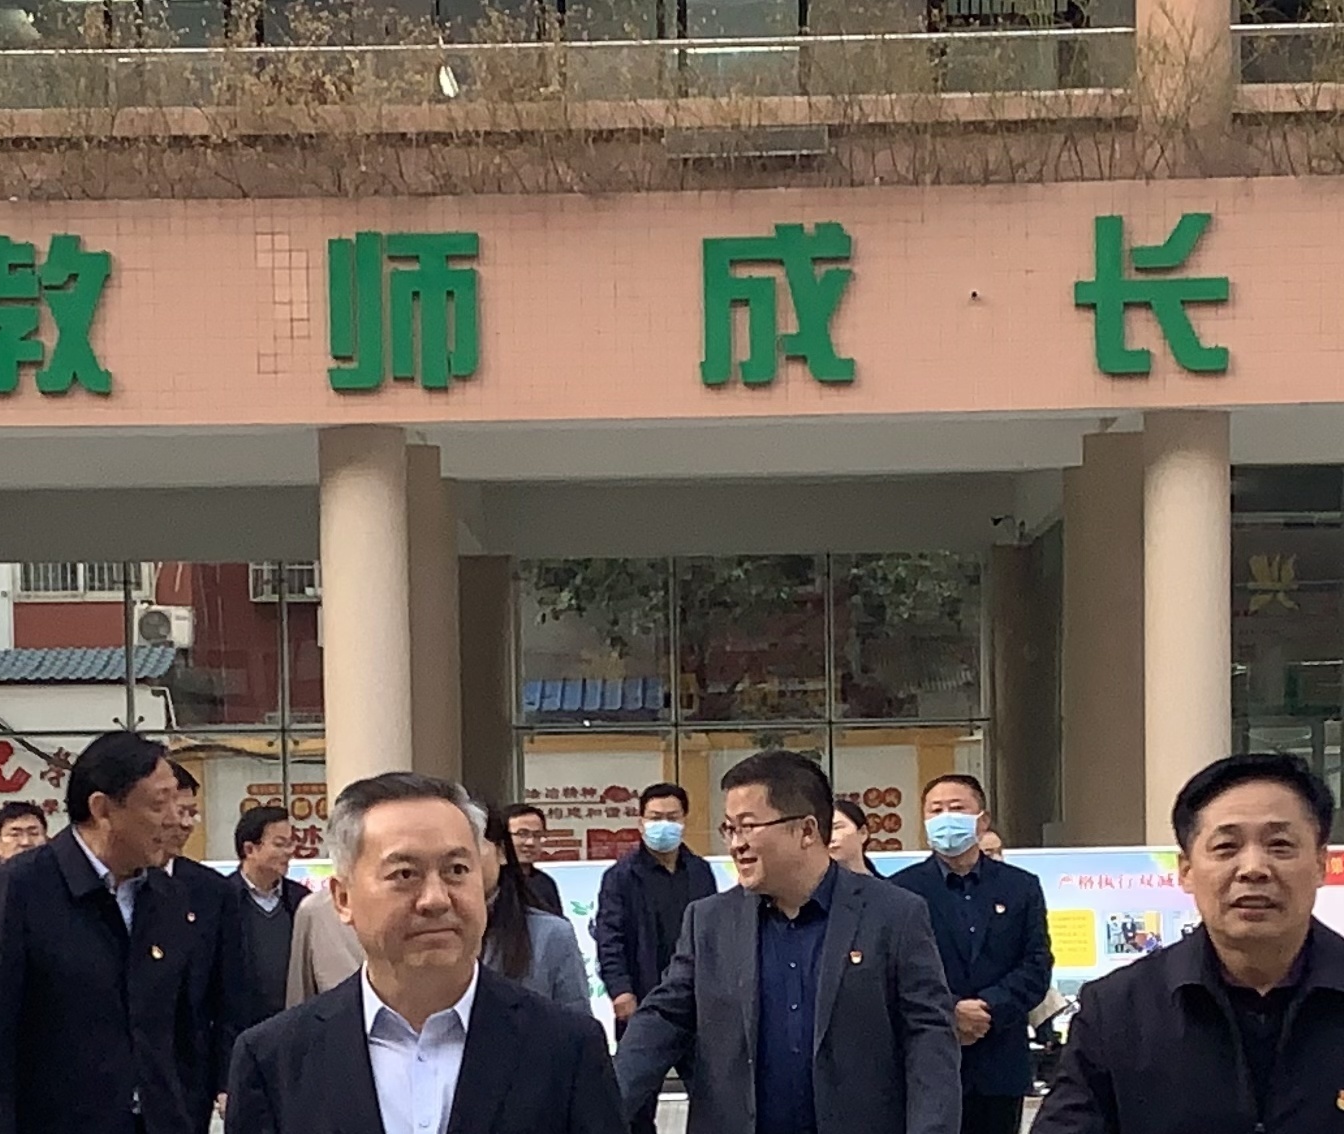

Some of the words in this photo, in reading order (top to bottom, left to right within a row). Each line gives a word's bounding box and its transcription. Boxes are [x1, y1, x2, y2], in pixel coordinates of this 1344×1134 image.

[1058, 872, 1182, 890] 严格执行双减
